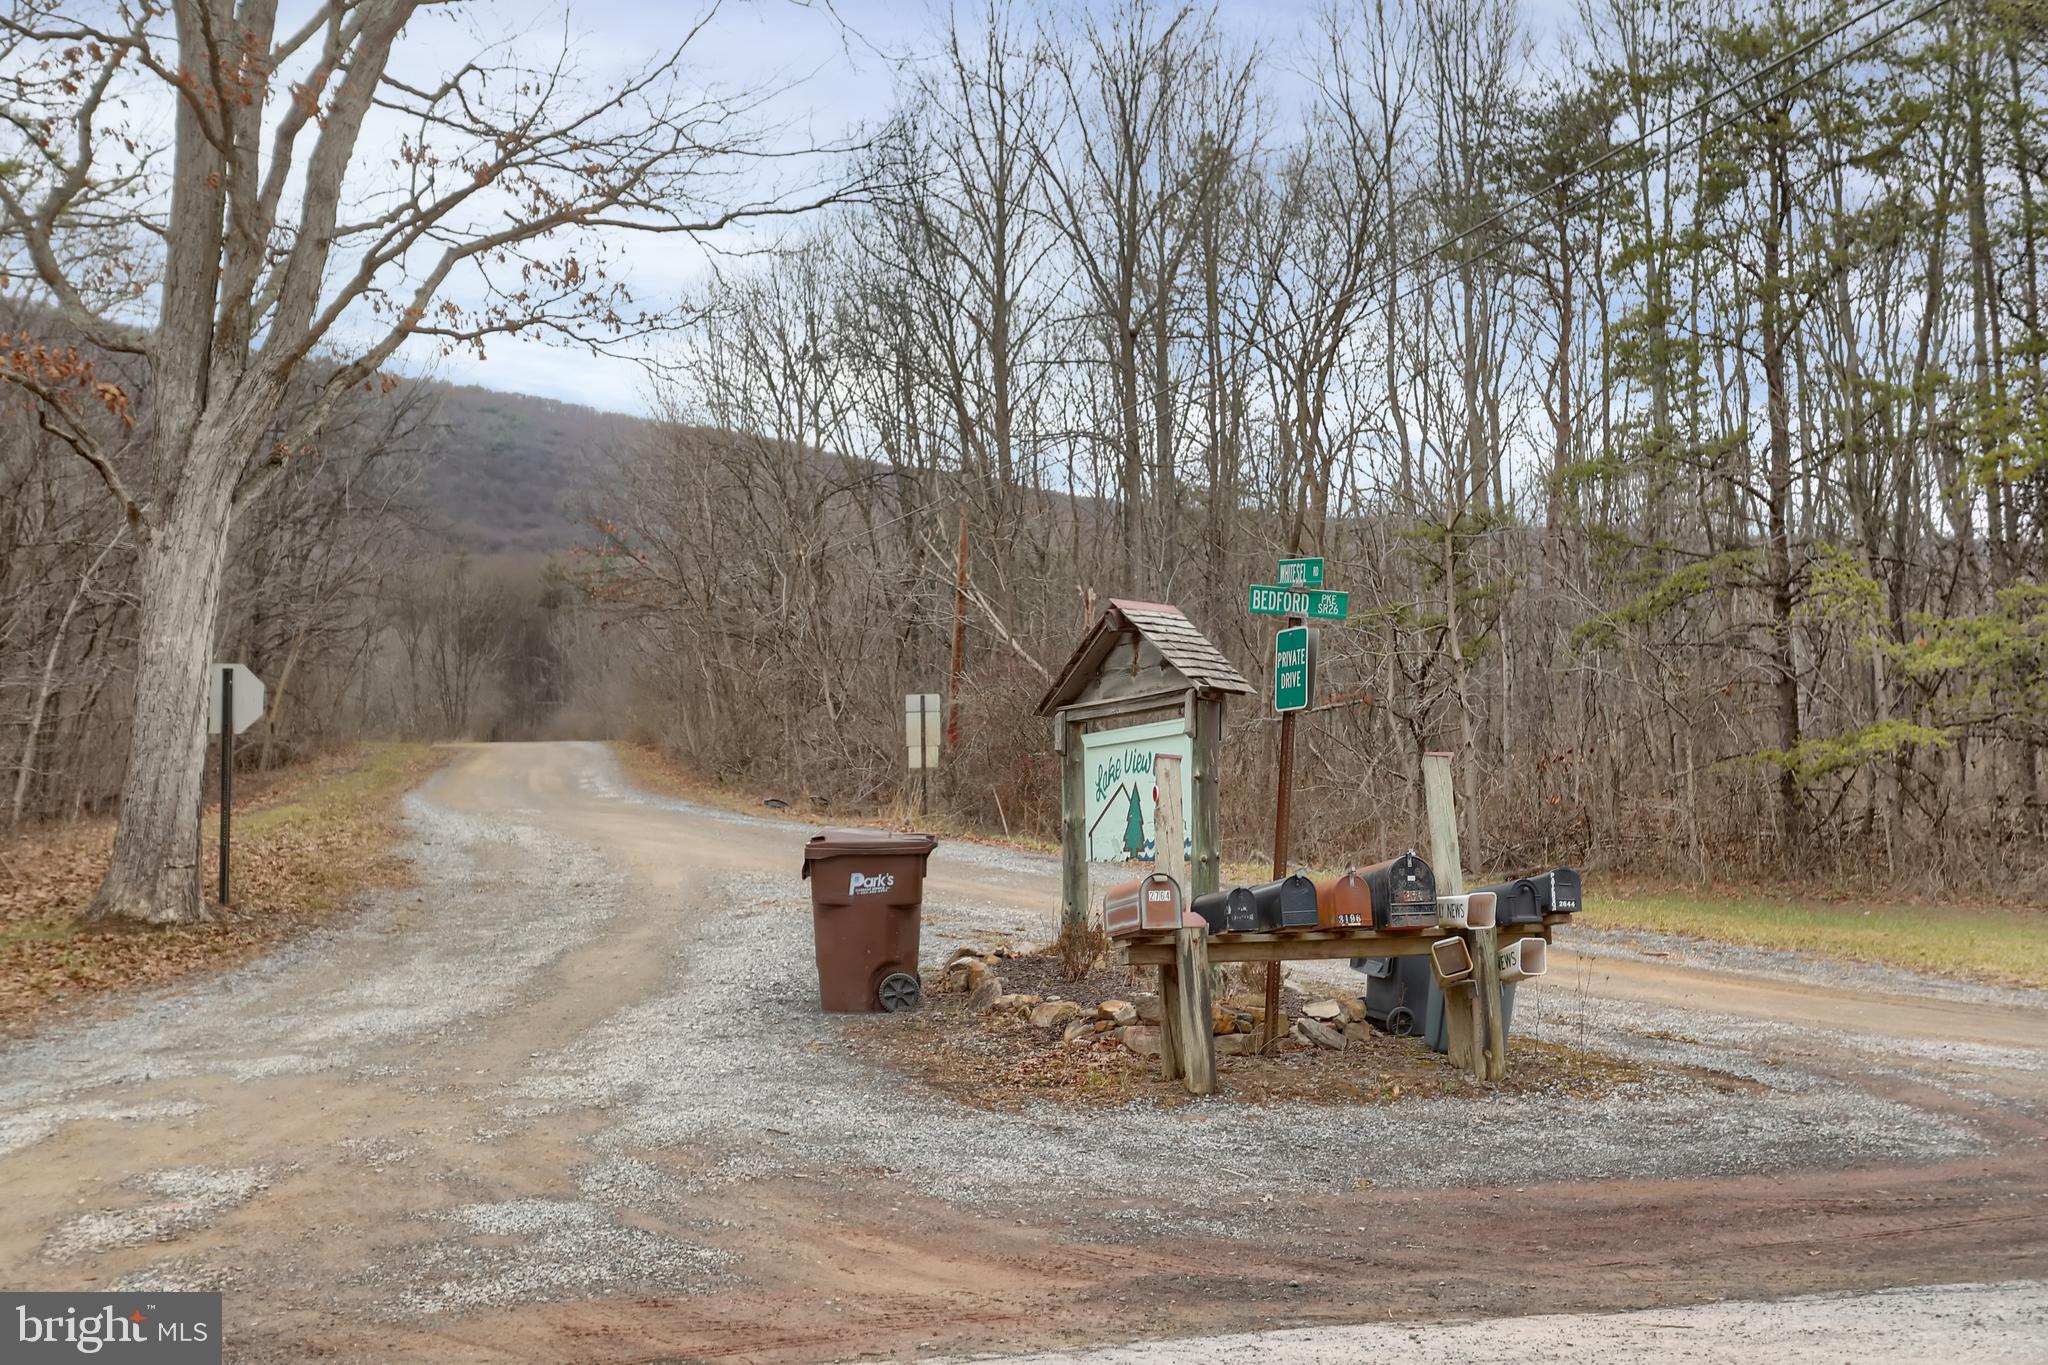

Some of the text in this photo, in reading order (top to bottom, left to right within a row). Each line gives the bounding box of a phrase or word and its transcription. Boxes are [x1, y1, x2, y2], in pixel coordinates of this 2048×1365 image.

[1279, 563, 1319, 583] WHITESEL RD
[1252, 589, 1310, 612] BEDFORD
[1317, 603, 1339, 615] SR26
[1321, 594, 1337, 605] PKE
[1277, 648, 1306, 669] PRIVATE
[1280, 670, 1301, 689] DRIVE
[1095, 756, 1122, 802] Lake
[1124, 748, 1152, 775] View
[848, 872, 894, 896] Park's
[1149, 890, 1170, 901] 2764
[1446, 903, 1465, 918] NEWS
